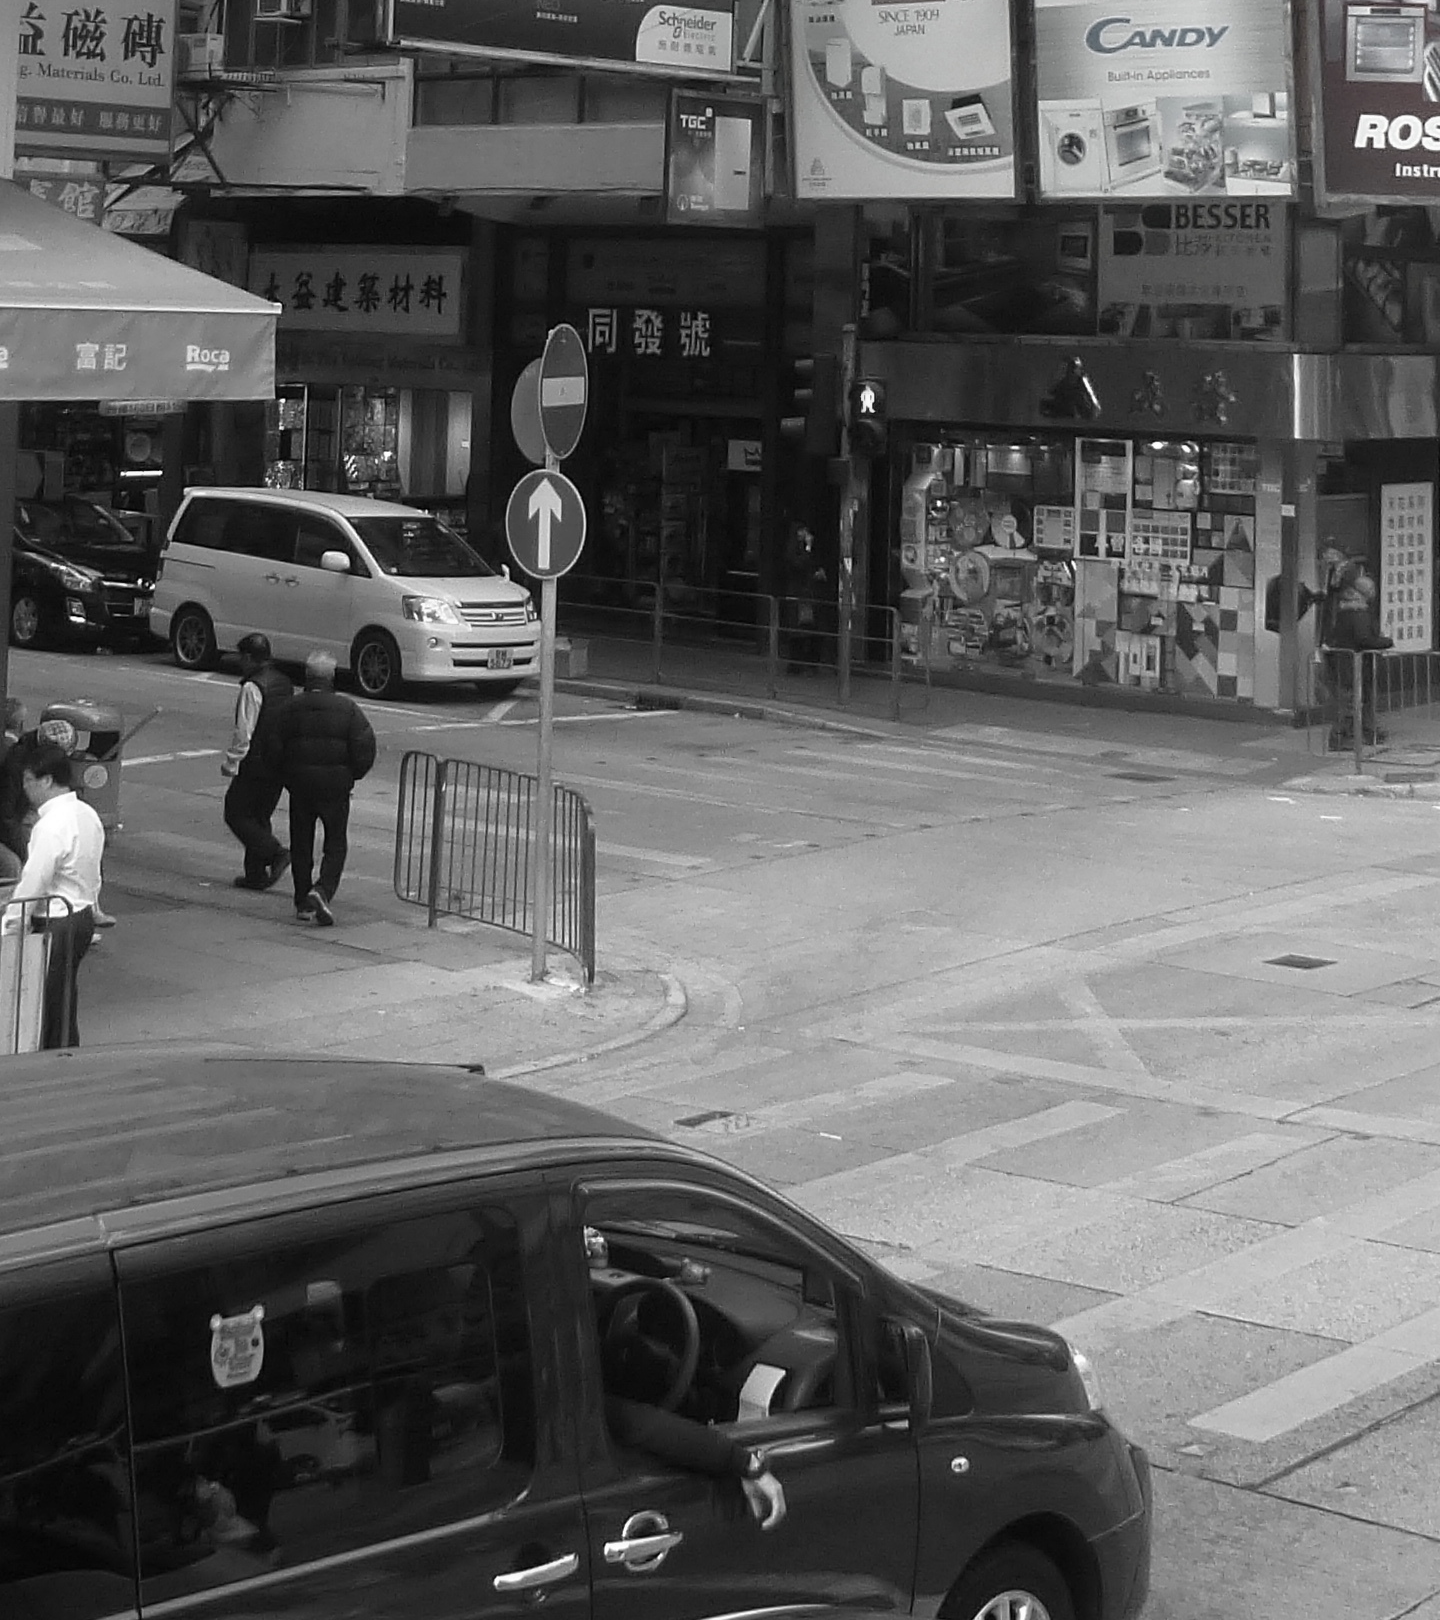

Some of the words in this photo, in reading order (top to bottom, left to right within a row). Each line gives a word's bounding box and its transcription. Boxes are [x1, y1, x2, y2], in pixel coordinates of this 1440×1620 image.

[658, 11, 717, 31] Schneider
[878, 9, 910, 24] SINCE
[913, 9, 940, 23] 1909
[894, 24, 926, 36] JAPAN
[1085, 16, 1230, 55] CANDY
[37, 63, 105, 82] Materials
[109, 70, 133, 85] Co.
[138, 71, 166, 87] Ltd.
[1147, 69, 1211, 83] Appliances
[680, 114, 706, 130] TGC
[1174, 203, 1270, 229] BESSER
[588, 308, 710, 357] 同發號
[75, 342, 128, 371] 富記
[186, 345, 231, 364] Roca
